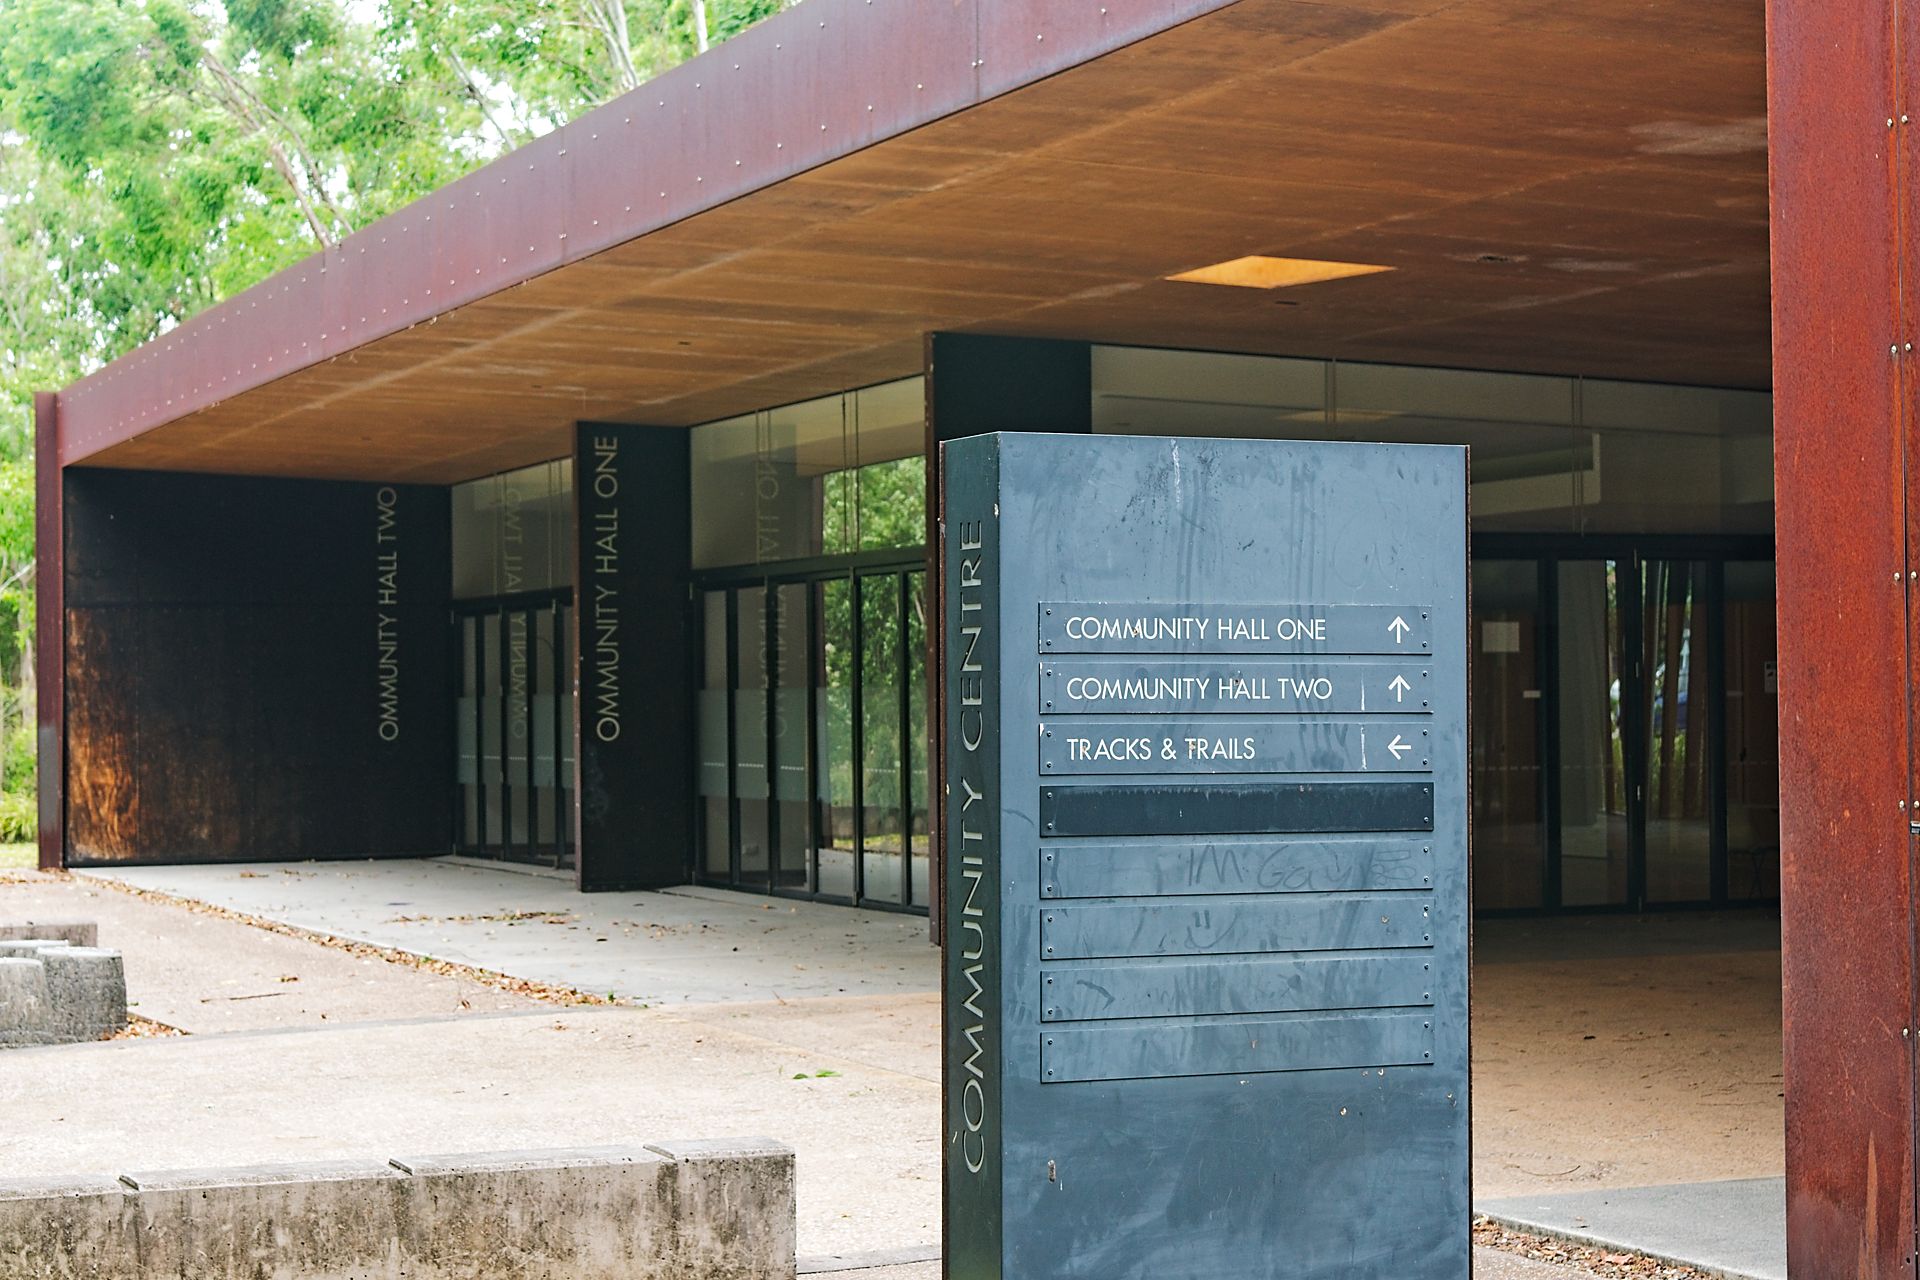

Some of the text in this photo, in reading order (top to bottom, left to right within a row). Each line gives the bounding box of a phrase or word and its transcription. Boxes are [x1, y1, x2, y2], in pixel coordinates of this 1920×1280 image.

[594, 436, 618, 498] ONE
[377, 486, 397, 544] TWO
[595, 508, 619, 573] HALL
[378, 551, 398, 605] HALL
[1065, 616, 1327, 640] COMMUNITY HALL ONE
[1066, 677, 1334, 700] COMMUNITY HALL TWO
[1066, 737, 1256, 761] TRACKS & TRAILS
[960, 519, 985, 1174] COMMUNITY CENTRE
